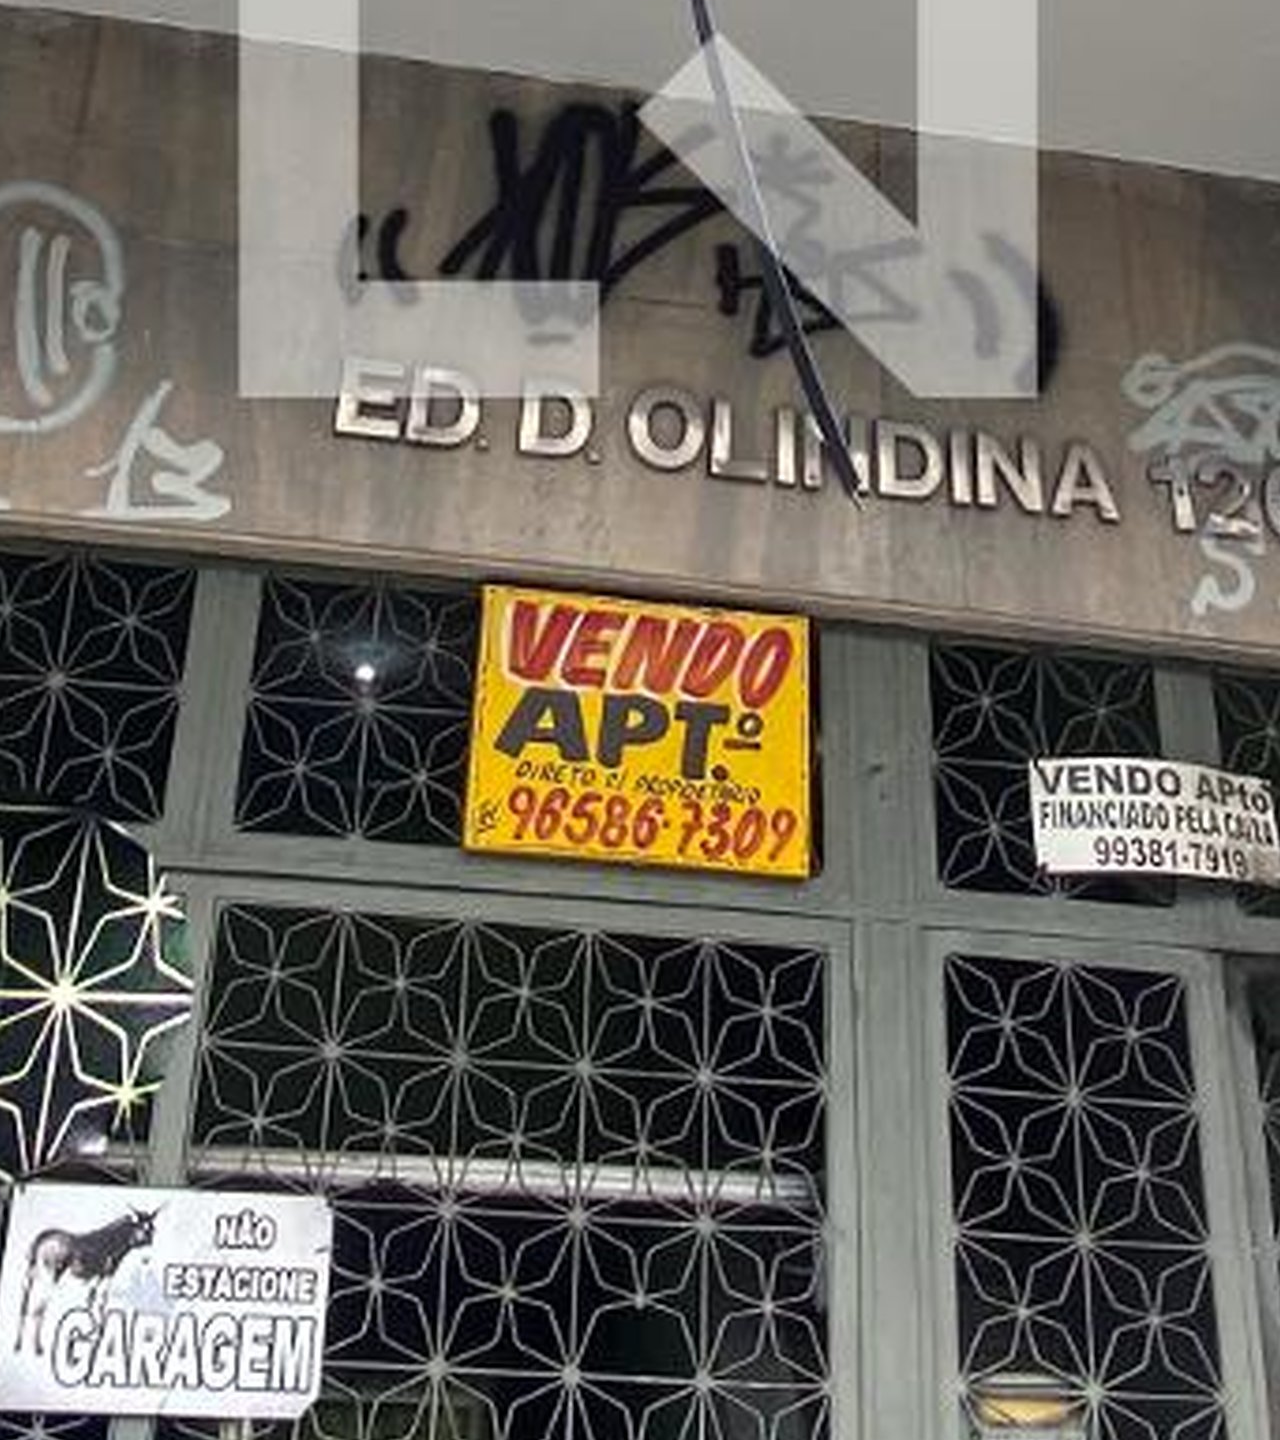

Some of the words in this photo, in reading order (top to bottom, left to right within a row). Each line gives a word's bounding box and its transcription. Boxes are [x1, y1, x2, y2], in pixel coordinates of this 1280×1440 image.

[628, 384, 1120, 522] OLINDINA
[506, 600, 794, 710] VENDO
[1036, 765, 1182, 798] VENDO
[1040, 799, 1170, 831] FINANCIADO
[1175, 805, 1221, 838] PELA
[215, 1208, 277, 1251] NÃO
[165, 1262, 319, 1305] ESTACIONE
[51, 1307, 318, 1394] GARAGEM
